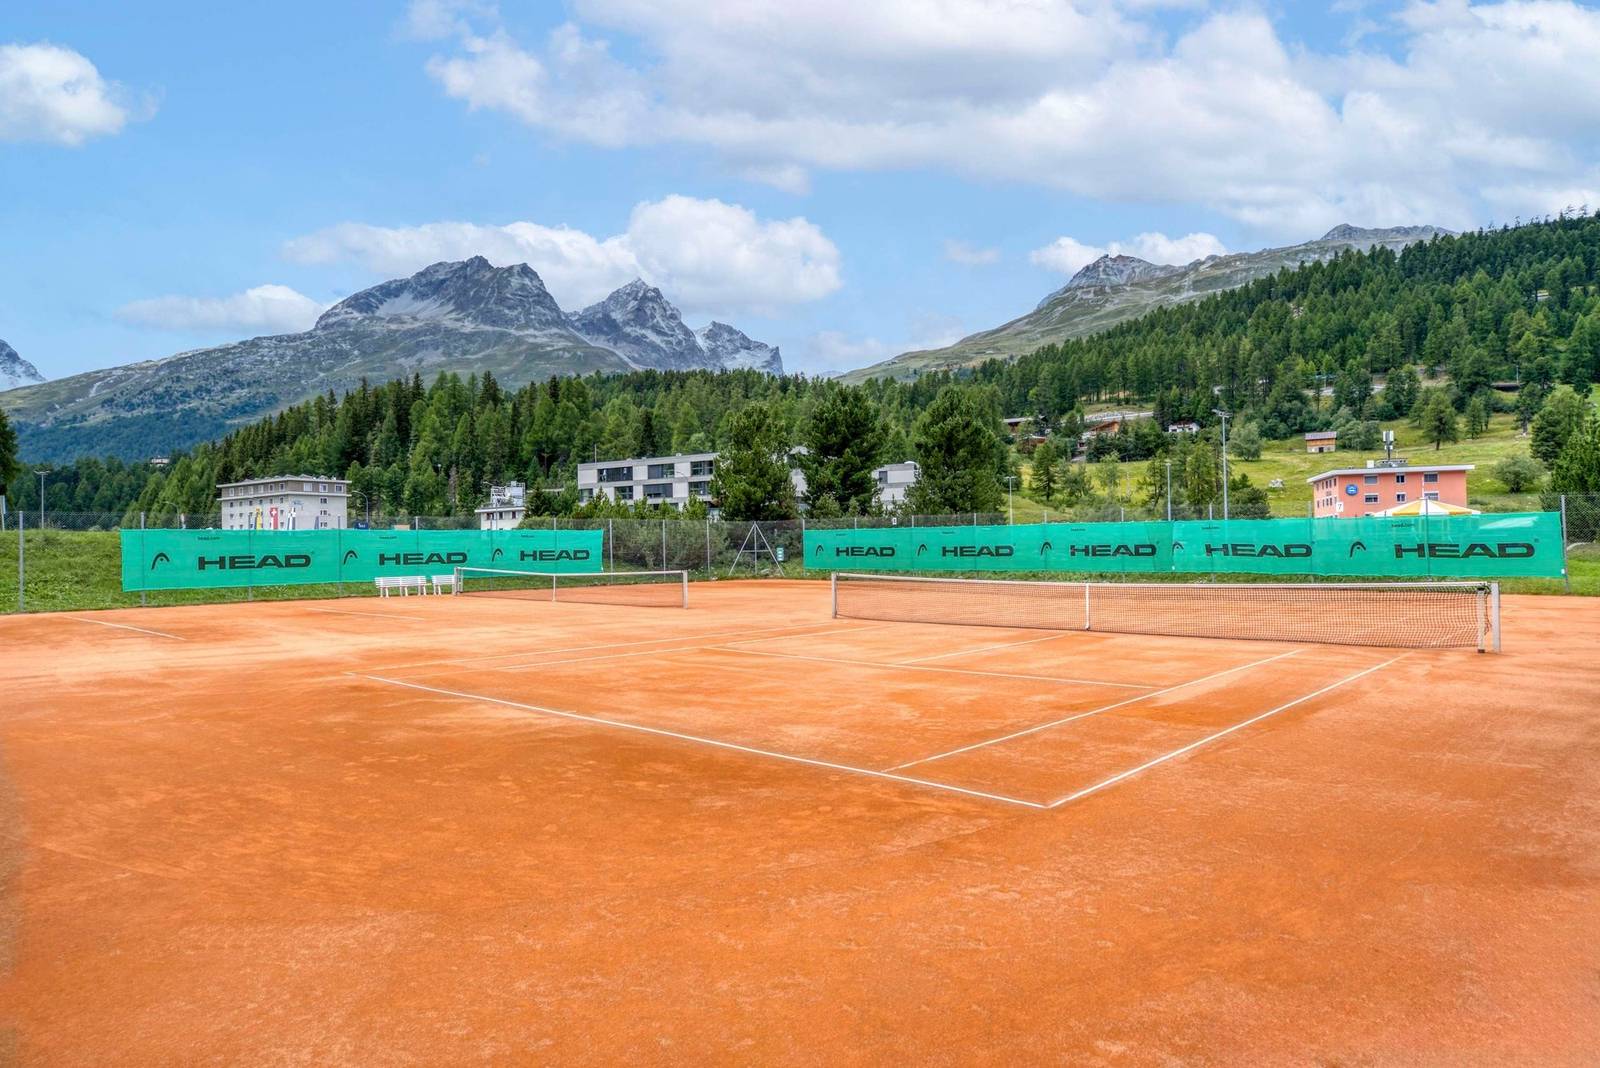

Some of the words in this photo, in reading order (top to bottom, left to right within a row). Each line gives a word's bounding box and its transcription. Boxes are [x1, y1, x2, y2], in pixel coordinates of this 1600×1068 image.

[521, 549, 589, 561] HEAD
[836, 546, 895, 557] HEAD
[942, 546, 1013, 557] HEAD
[1070, 544, 1156, 557] HEAD
[1205, 543, 1312, 558] HEAD
[1394, 543, 1535, 559] HEAD
[199, 554, 310, 571] HEAD
[380, 552, 467, 566] HEAD
